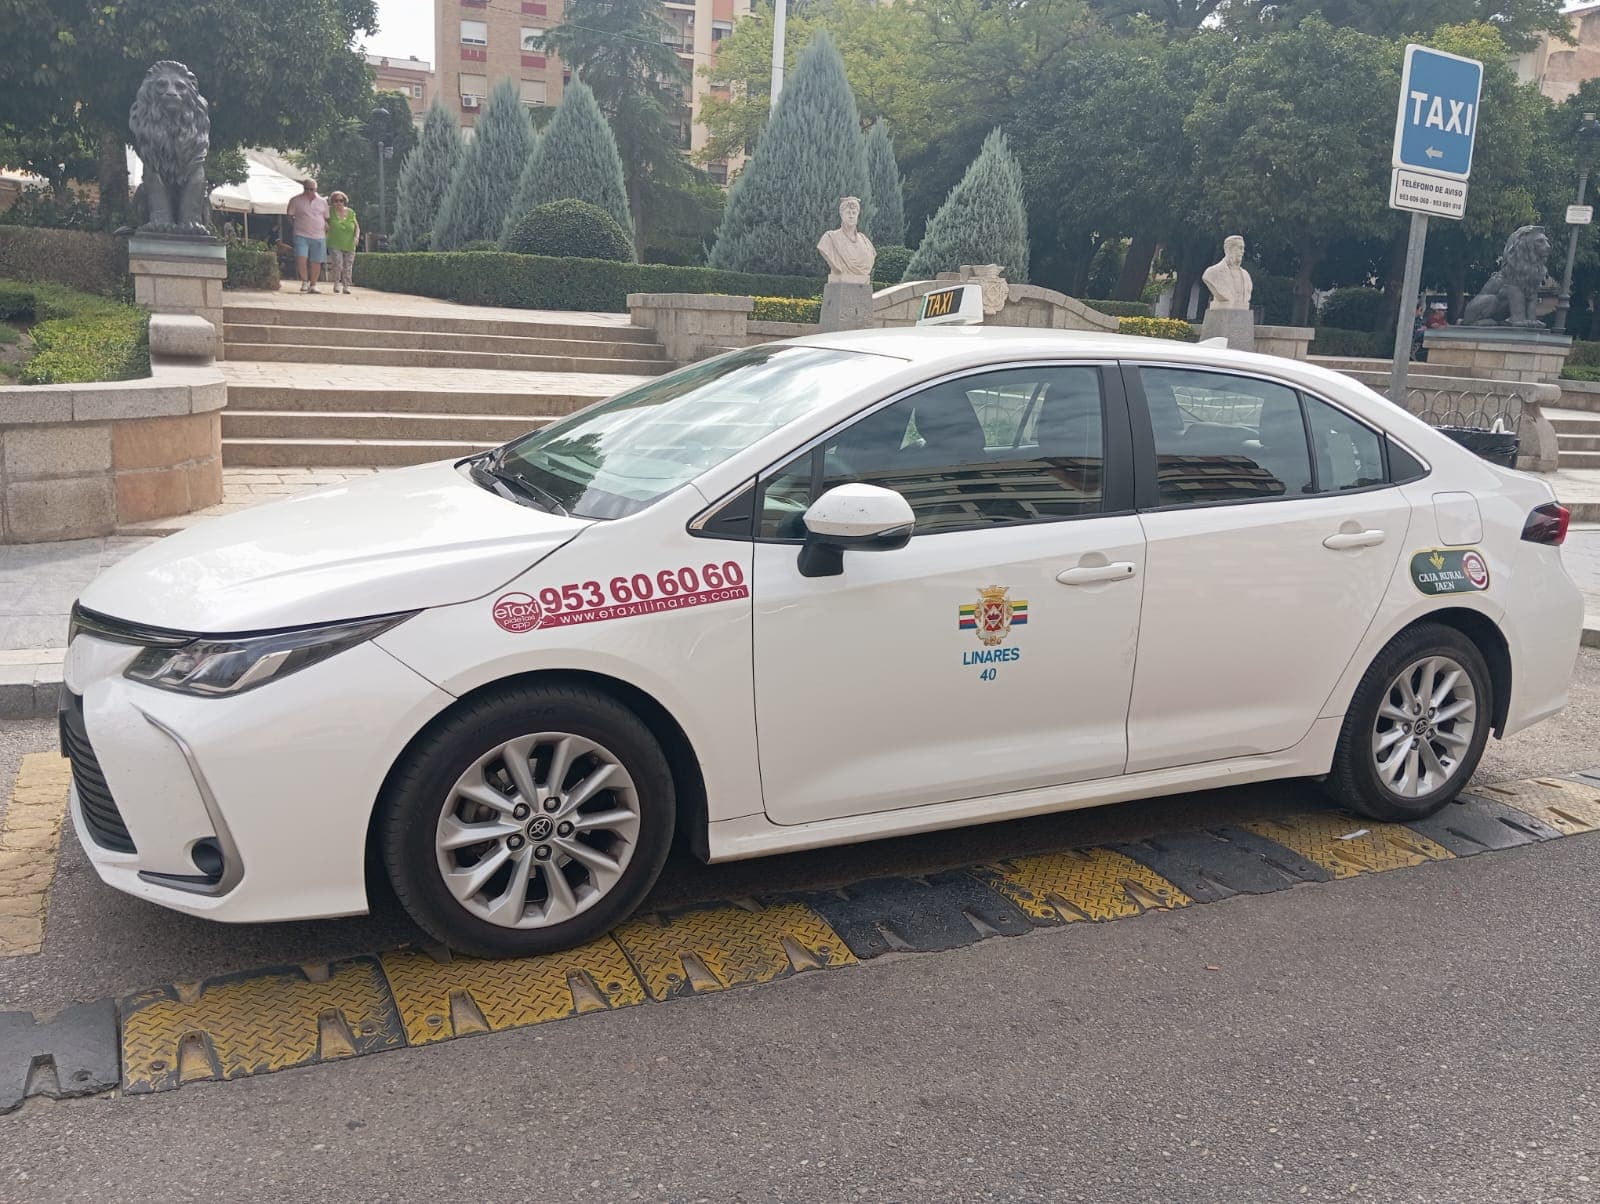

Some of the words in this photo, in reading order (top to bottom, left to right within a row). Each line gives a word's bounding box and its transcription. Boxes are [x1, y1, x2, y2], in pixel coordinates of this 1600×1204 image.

[1410, 90, 1473, 136] TAXI
[1435, 186, 1444, 194] DE
[1445, 187, 1463, 198] AVISO
[927, 290, 954, 317] TAXI
[1418, 572, 1439, 583] CAJA
[1440, 570, 1465, 581] RURAL
[540, 581, 606, 614] 953
[609, 573, 654, 604] 60
[656, 566, 700, 596] 60
[702, 560, 744, 589] 60
[560, 587, 745, 624] www.etaxilinares.com
[511, 621, 531, 631] app
[962, 647, 1021, 666] LINARES
[980, 667, 998, 682] 40
